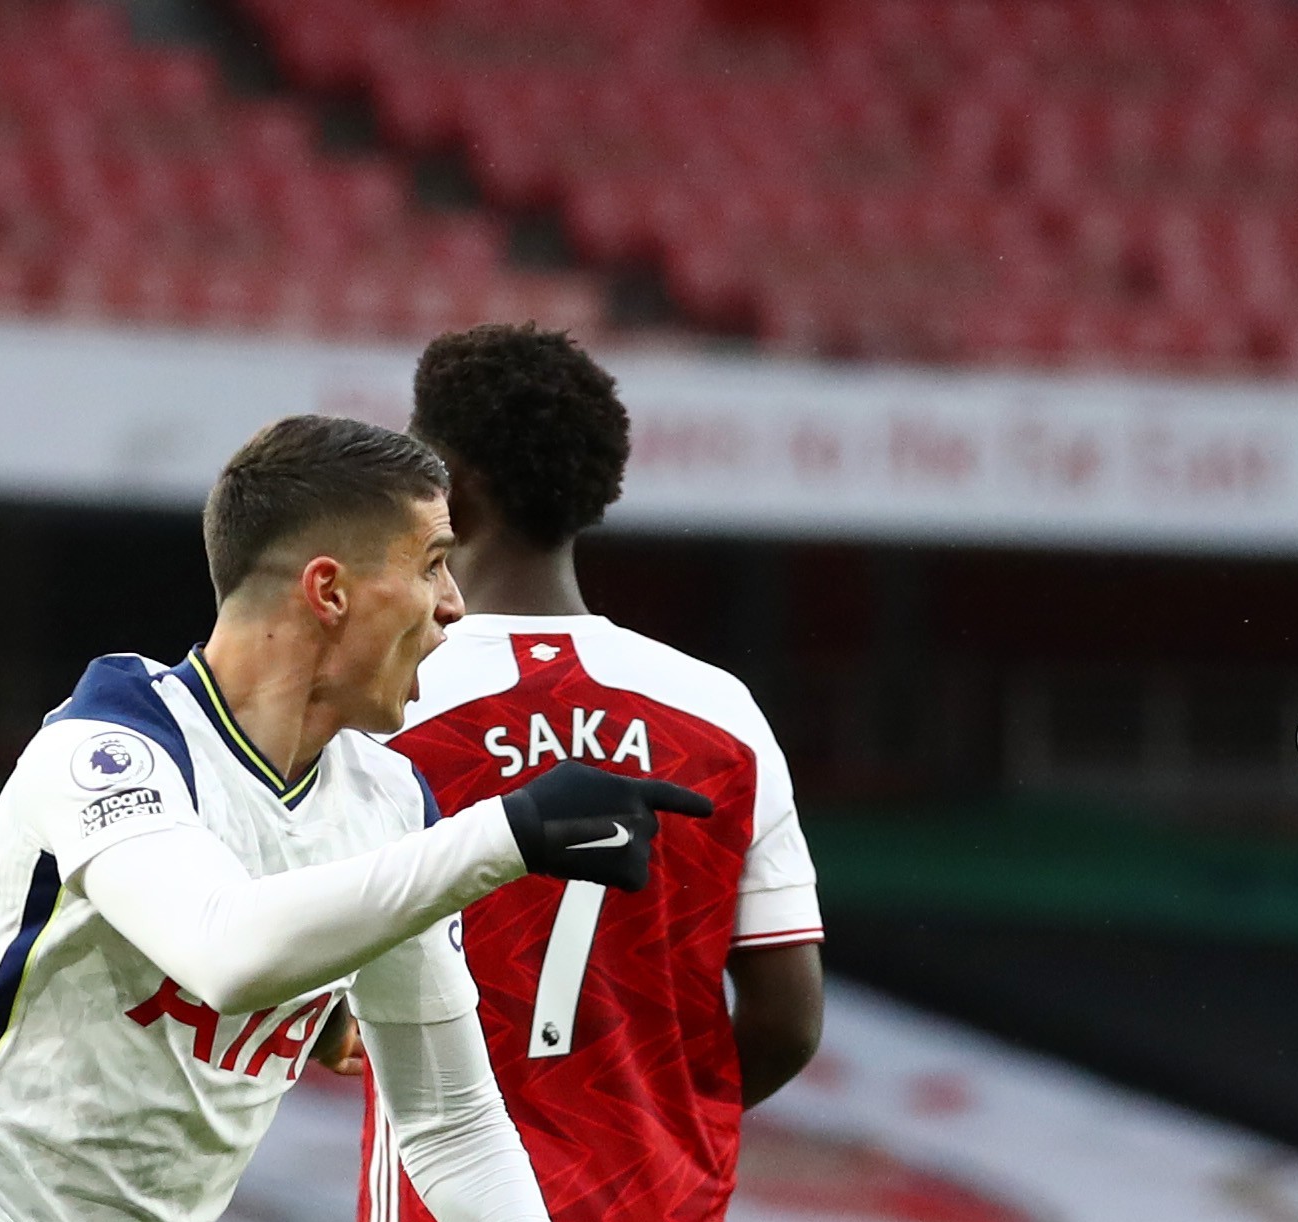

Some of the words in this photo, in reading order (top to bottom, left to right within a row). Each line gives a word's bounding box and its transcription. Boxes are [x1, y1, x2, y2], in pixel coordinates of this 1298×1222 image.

[483, 707, 652, 778] SAKA
[101, 788, 155, 814] room
[124, 975, 333, 1081] AIA
